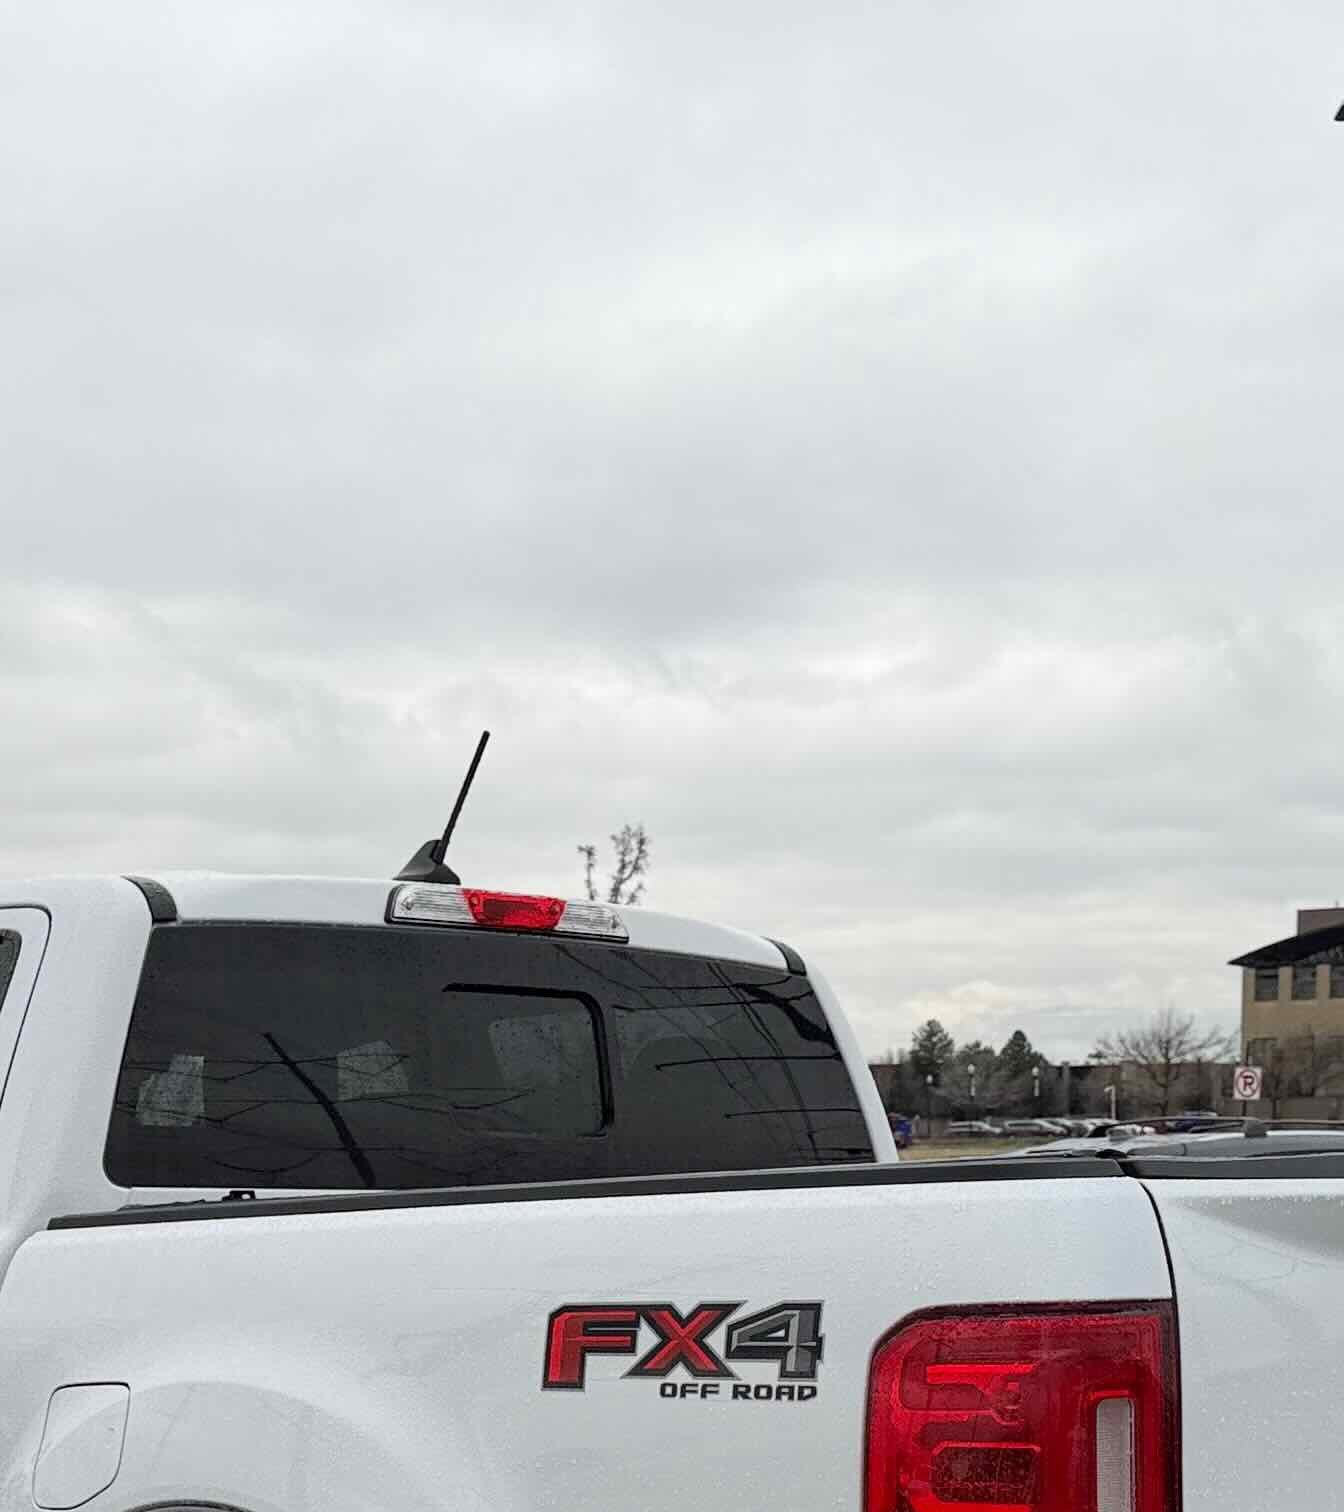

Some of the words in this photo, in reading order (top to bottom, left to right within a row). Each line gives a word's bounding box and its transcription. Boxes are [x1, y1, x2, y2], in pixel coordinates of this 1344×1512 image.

[542, 1301, 824, 1390] FX4
[659, 1383, 720, 1399] OFF
[732, 1383, 818, 1401] ROAD
